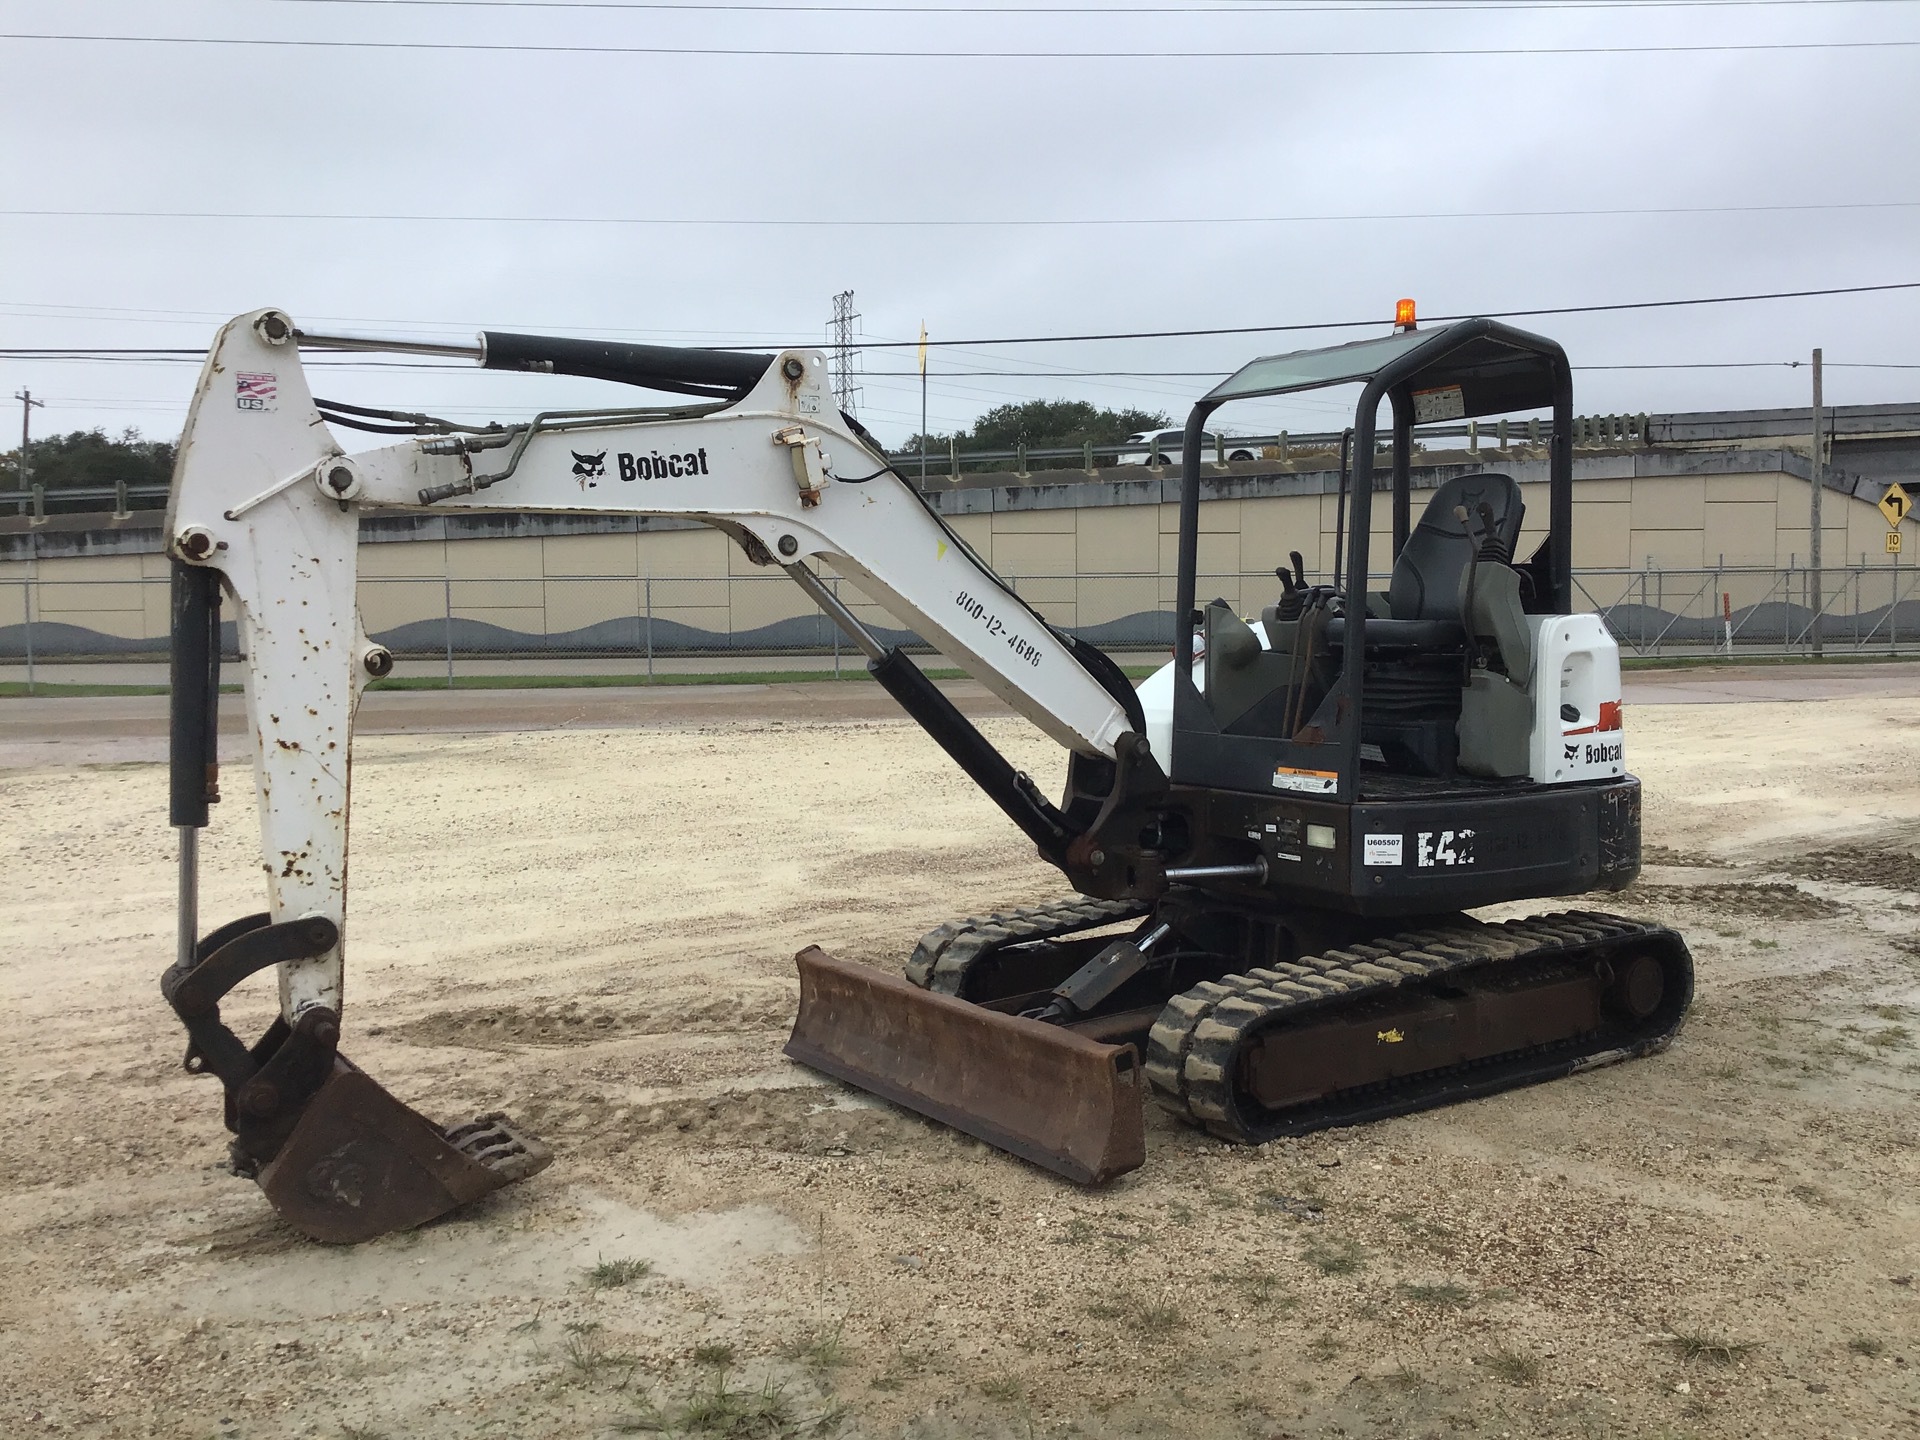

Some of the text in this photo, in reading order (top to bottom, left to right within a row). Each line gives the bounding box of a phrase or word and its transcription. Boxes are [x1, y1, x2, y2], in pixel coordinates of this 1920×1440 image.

[617, 447, 709, 482] Bobcat
[1888, 534, 1899, 545] 10
[1585, 742, 1622, 764] Bobcat
